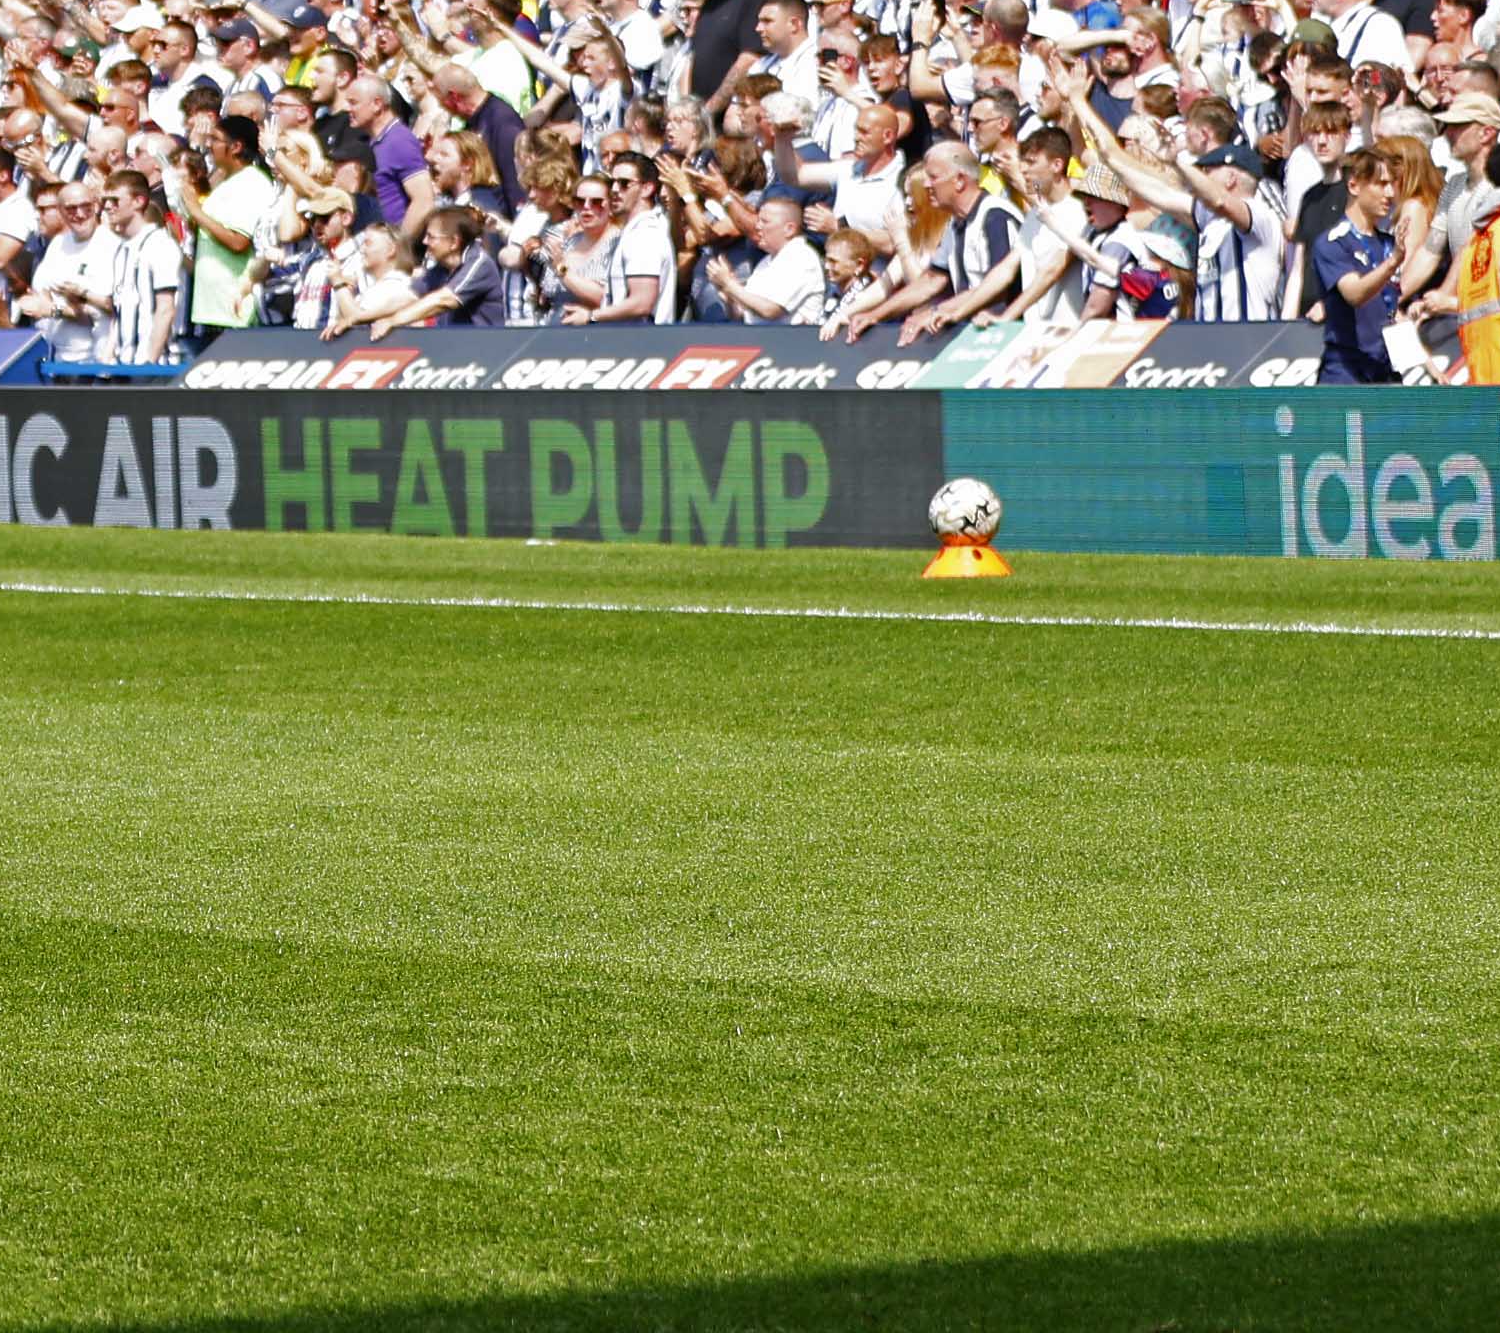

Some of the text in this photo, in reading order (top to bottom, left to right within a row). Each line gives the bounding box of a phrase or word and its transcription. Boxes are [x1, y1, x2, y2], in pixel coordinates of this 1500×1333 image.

[93, 416, 237, 531] AIR
[261, 416, 504, 538] HEAT
[528, 419, 830, 549] PUMP
